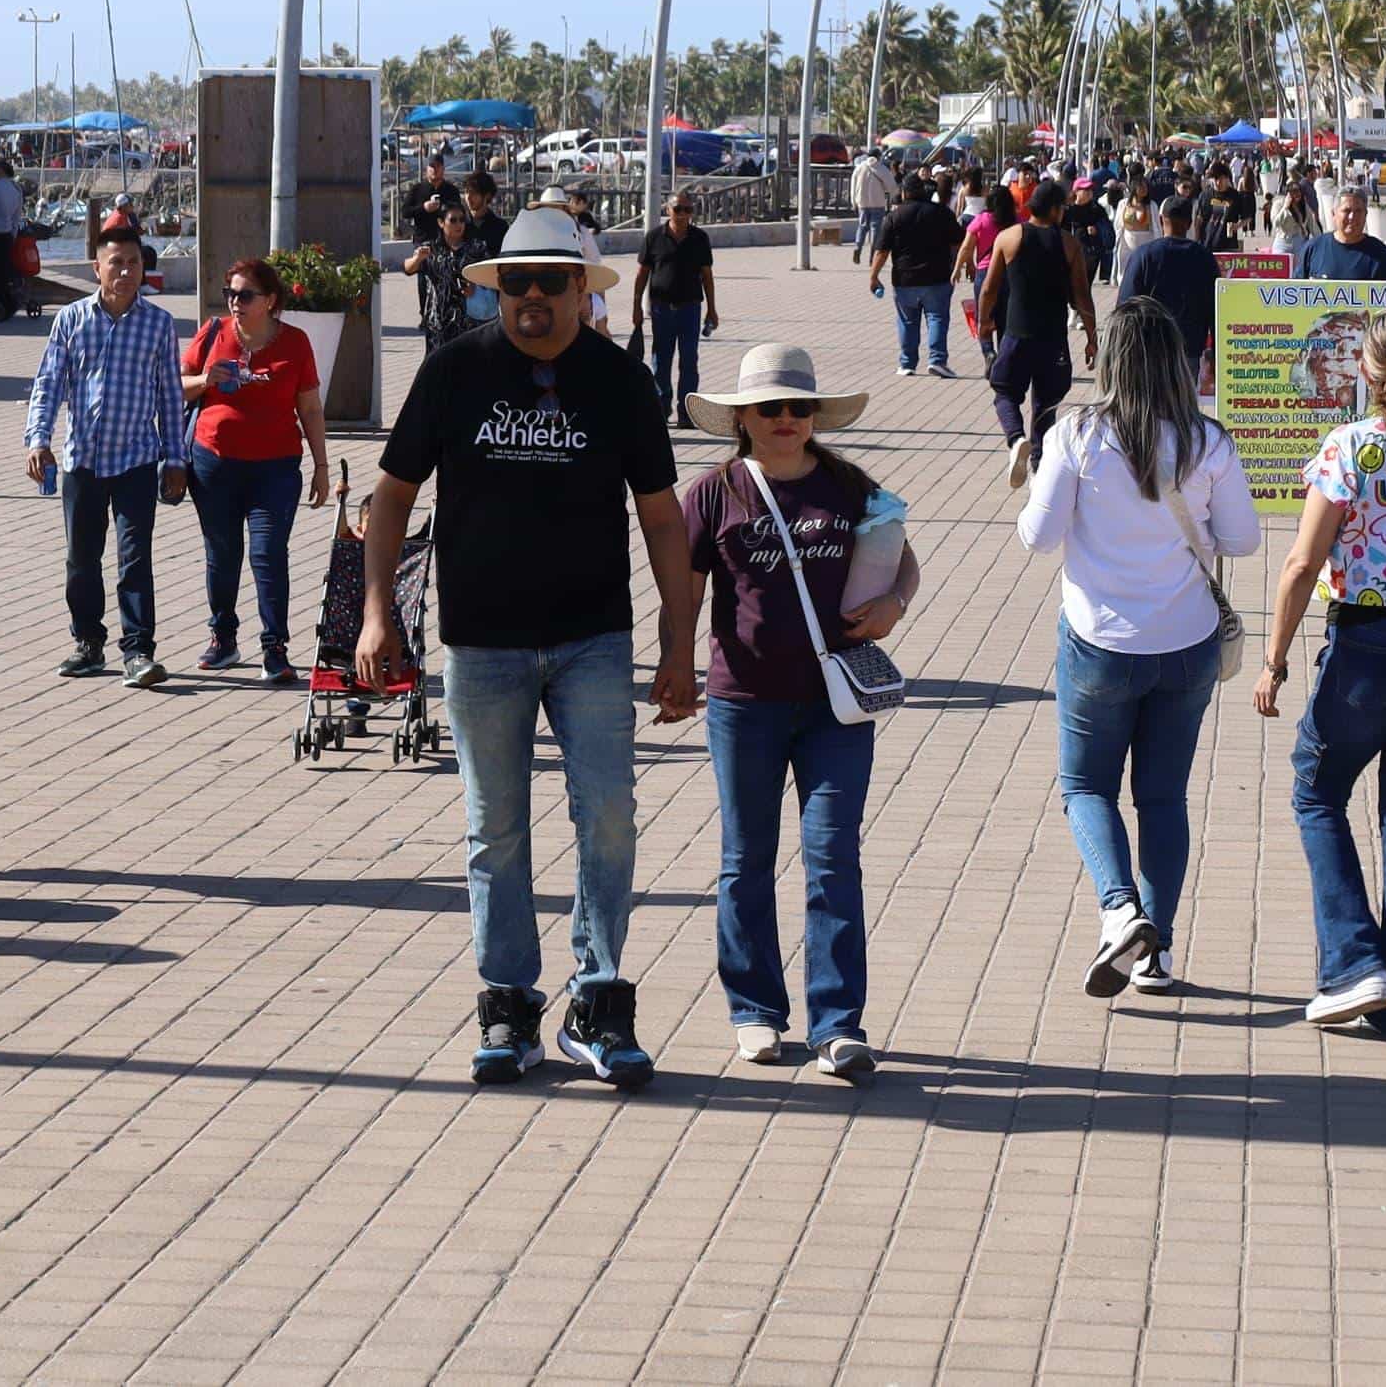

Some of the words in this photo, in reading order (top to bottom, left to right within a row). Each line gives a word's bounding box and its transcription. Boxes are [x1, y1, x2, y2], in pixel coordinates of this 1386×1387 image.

[1259, 286, 1329, 306] VISTA
[1331, 286, 1364, 306] AL
[1232, 324, 1293, 334] ESQUITES
[1232, 369, 1280, 379] ELOTES
[1233, 398, 1280, 408] FRESAS
[488, 400, 578, 433] Sporty
[1233, 413, 1288, 423] MANGOS
[1293, 413, 1367, 423] PREPARAD
[474, 421, 588, 448] Athletic
[1234, 428, 1318, 439] TOSTI-LOCOS
[1280, 489, 1288, 499] Y
[834, 514, 850, 532] in
[749, 550, 784, 572] my
